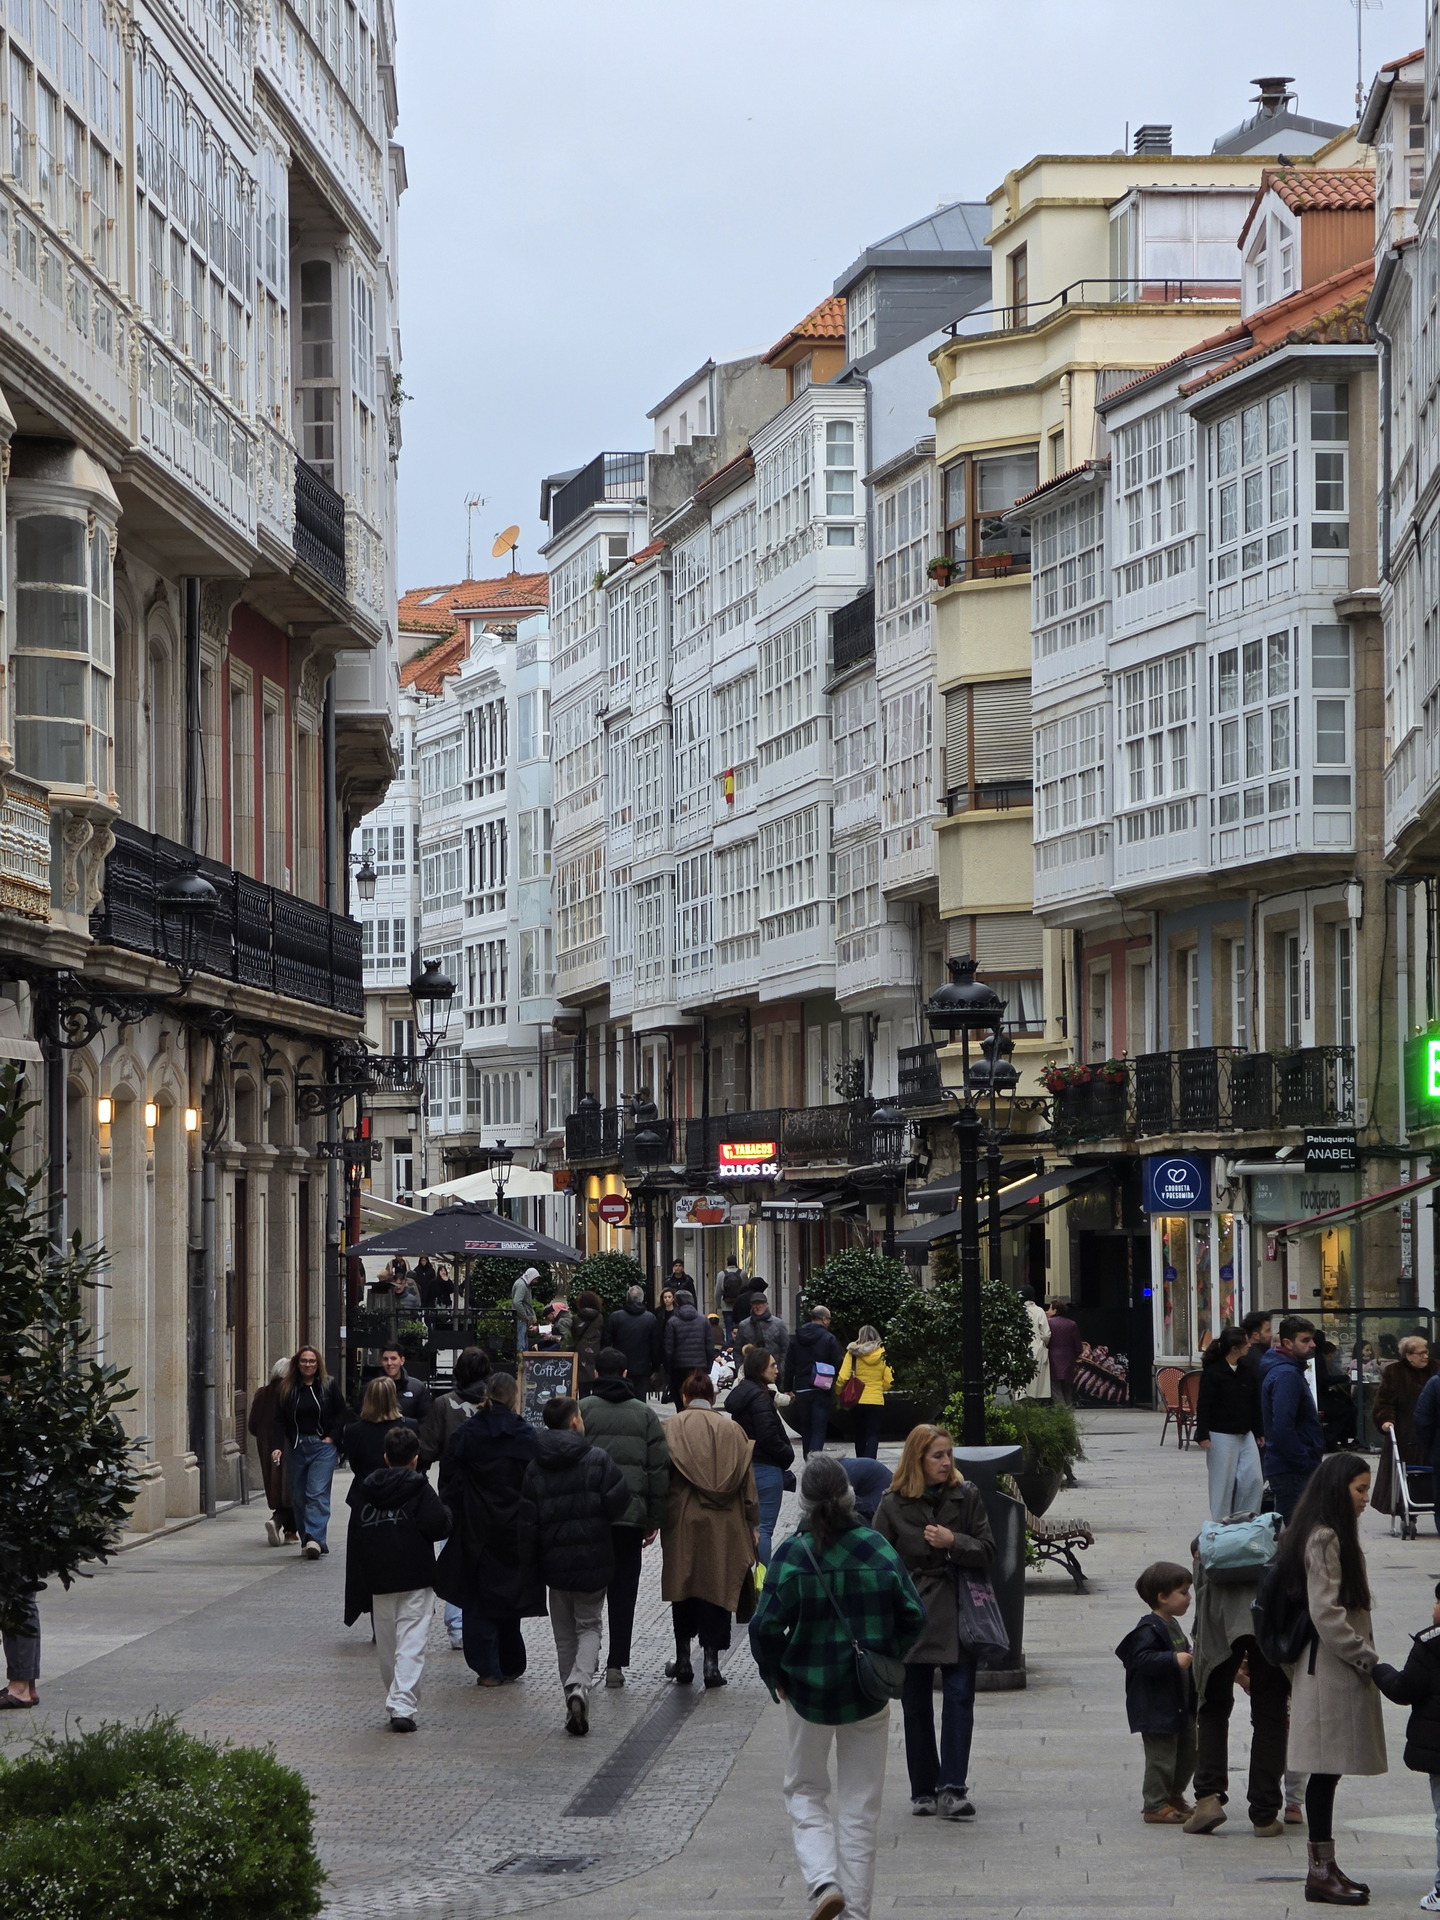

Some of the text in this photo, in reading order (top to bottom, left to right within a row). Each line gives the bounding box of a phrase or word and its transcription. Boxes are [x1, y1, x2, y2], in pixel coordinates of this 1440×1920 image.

[1306, 1135, 1355, 1144] Peluquería
[734, 1143, 773, 1155] TABACOS
[1307, 1149, 1355, 1159] ANABEL
[532, 1362, 567, 1377] Coffee
